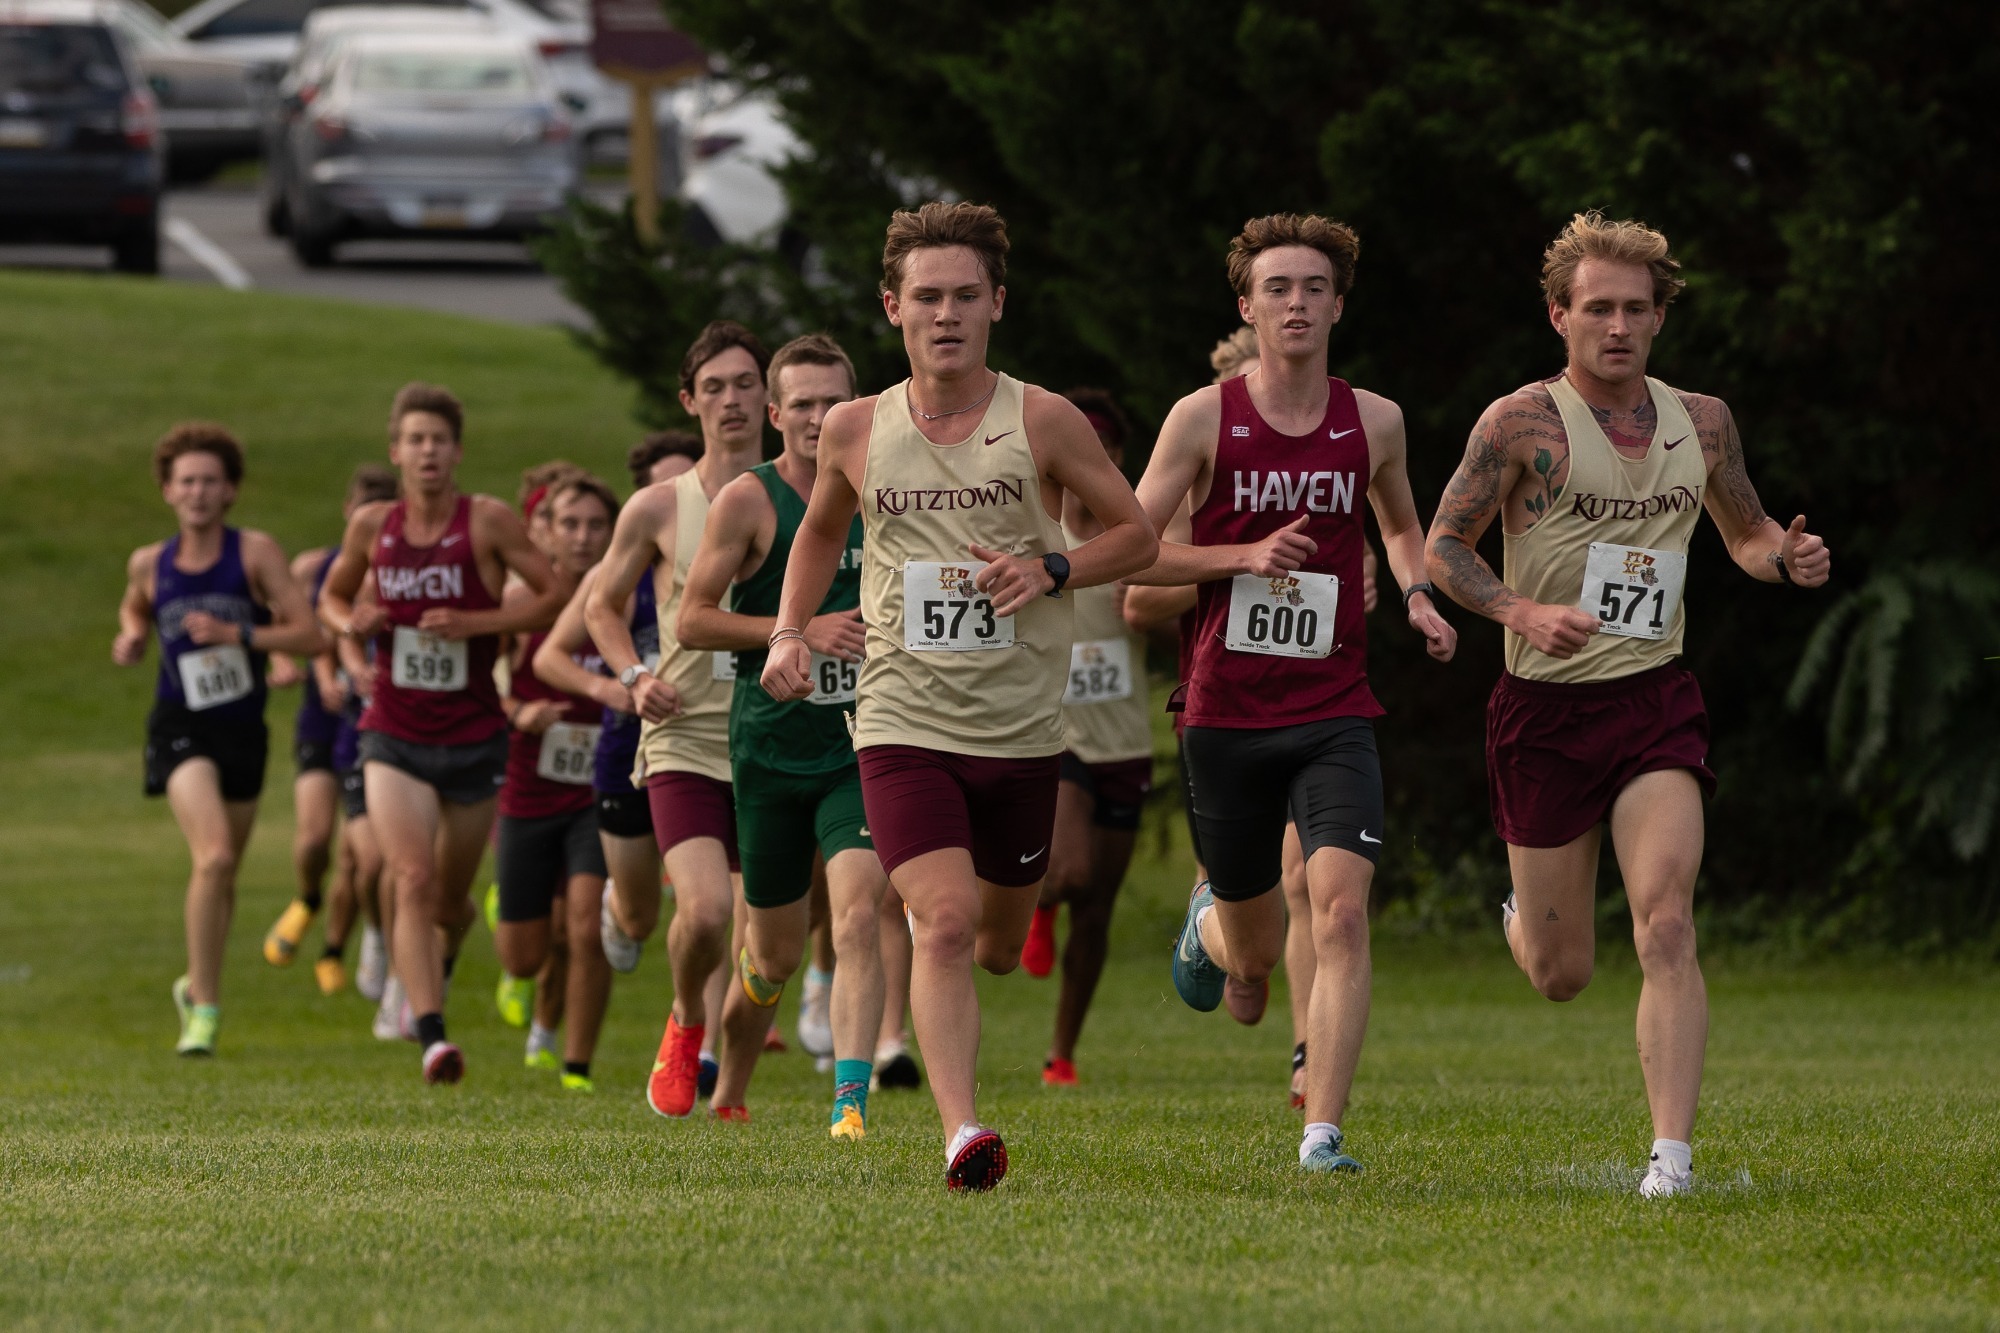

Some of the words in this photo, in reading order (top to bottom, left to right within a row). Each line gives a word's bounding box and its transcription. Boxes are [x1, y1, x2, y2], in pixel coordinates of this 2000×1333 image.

[874, 479, 1023, 516] KUTZTOWN
[1234, 470, 1355, 514] HAVEN
[1570, 485, 1701, 521] KUTZTOWN
[377, 565, 463, 599] HAVEN
[939, 579, 957, 589] XC
[940, 567, 958, 578] PT
[923, 599, 996, 640] 573
[1599, 582, 1665, 628] 571
[1247, 603, 1318, 647] 600
[405, 653, 453, 682] 599
[819, 659, 857, 695] 65
[1071, 664, 1121, 698] 582
